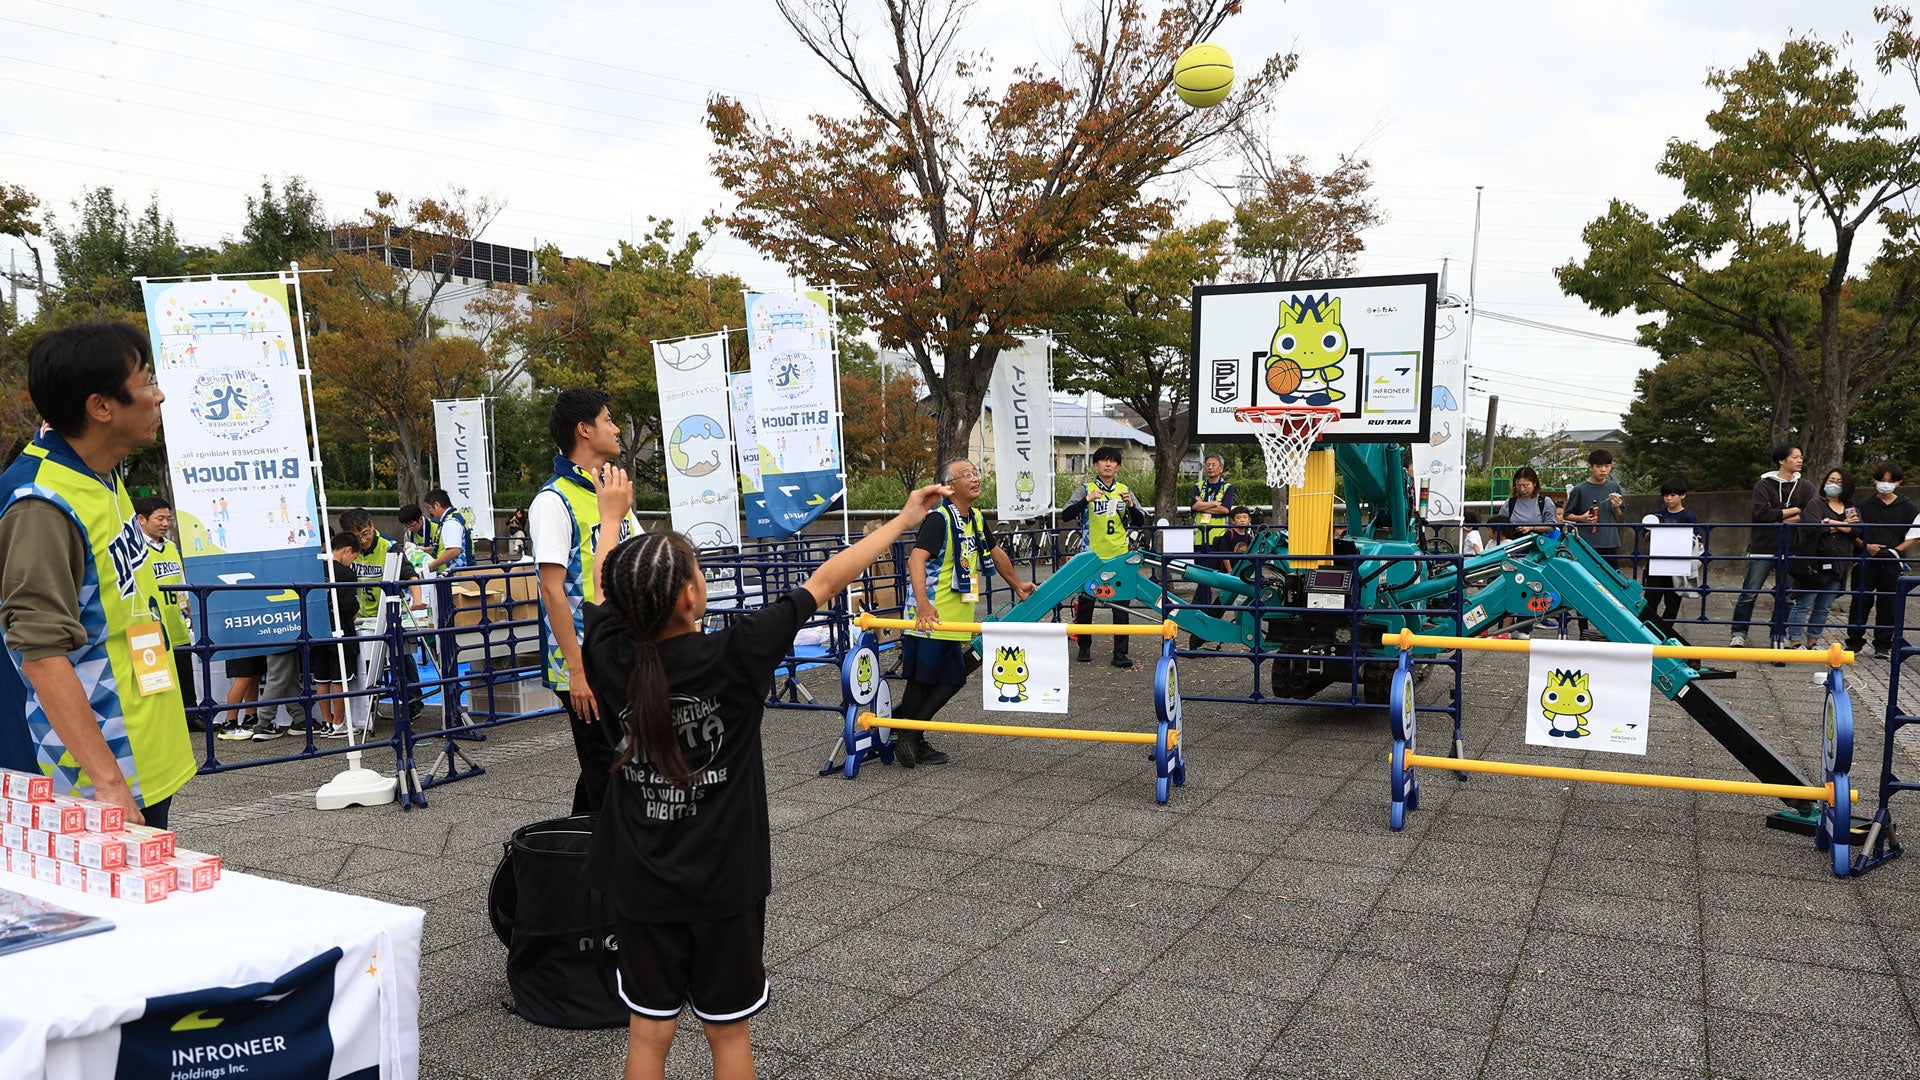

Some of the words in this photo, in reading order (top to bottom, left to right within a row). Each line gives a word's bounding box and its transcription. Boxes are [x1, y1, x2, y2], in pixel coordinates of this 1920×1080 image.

[1107, 519, 1115, 535] 6
[672, 696, 721, 727] SKETBALL
[622, 765, 646, 783] The
[641, 785, 655, 800] to
[658, 785, 686, 803] win
[691, 786, 705, 801] is
[646, 801, 698, 821] HIBITA
[172, 1036, 287, 1066] INFRONEER
[172, 1067, 226, 1080] Holdings
[228, 1062, 249, 1074] Inc.
